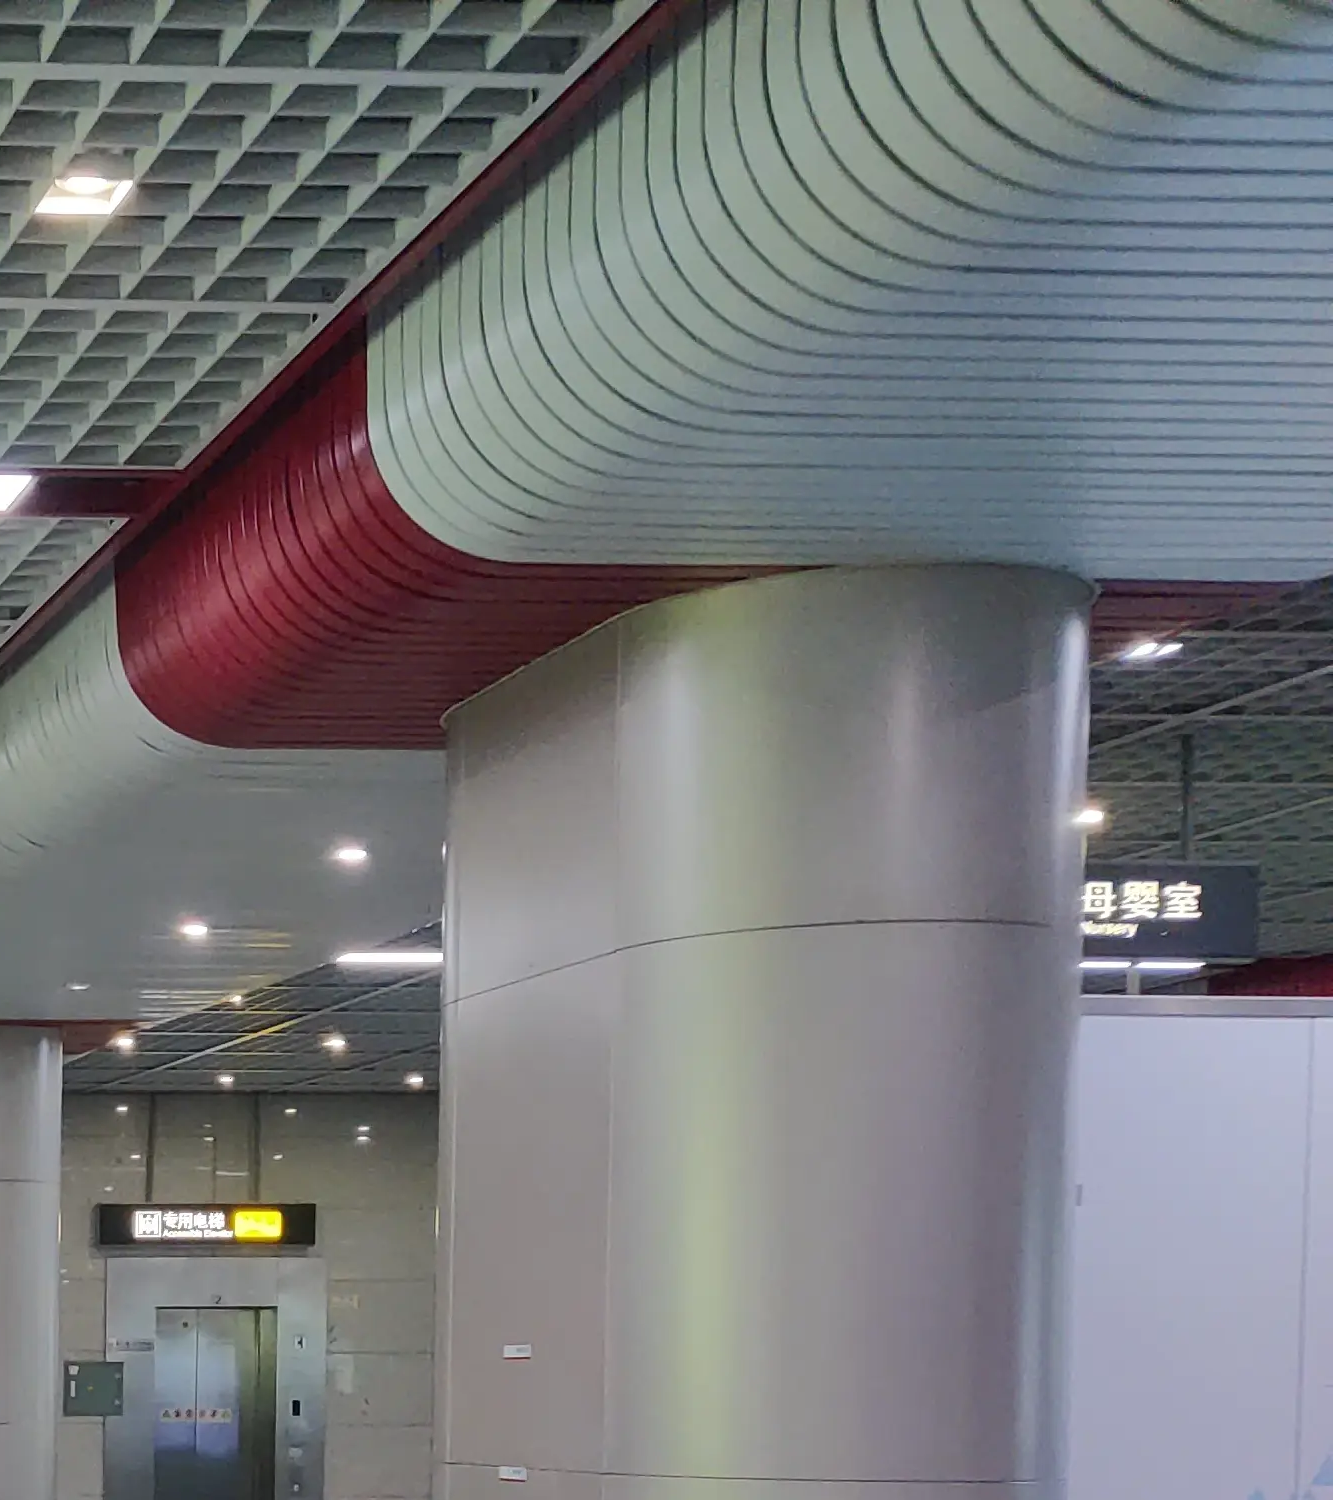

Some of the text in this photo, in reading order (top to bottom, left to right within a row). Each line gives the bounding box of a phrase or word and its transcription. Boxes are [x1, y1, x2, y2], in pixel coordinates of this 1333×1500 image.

[1080, 880, 1202, 920] 母婴室
[162, 1210, 226, 1230] 专用电梯
